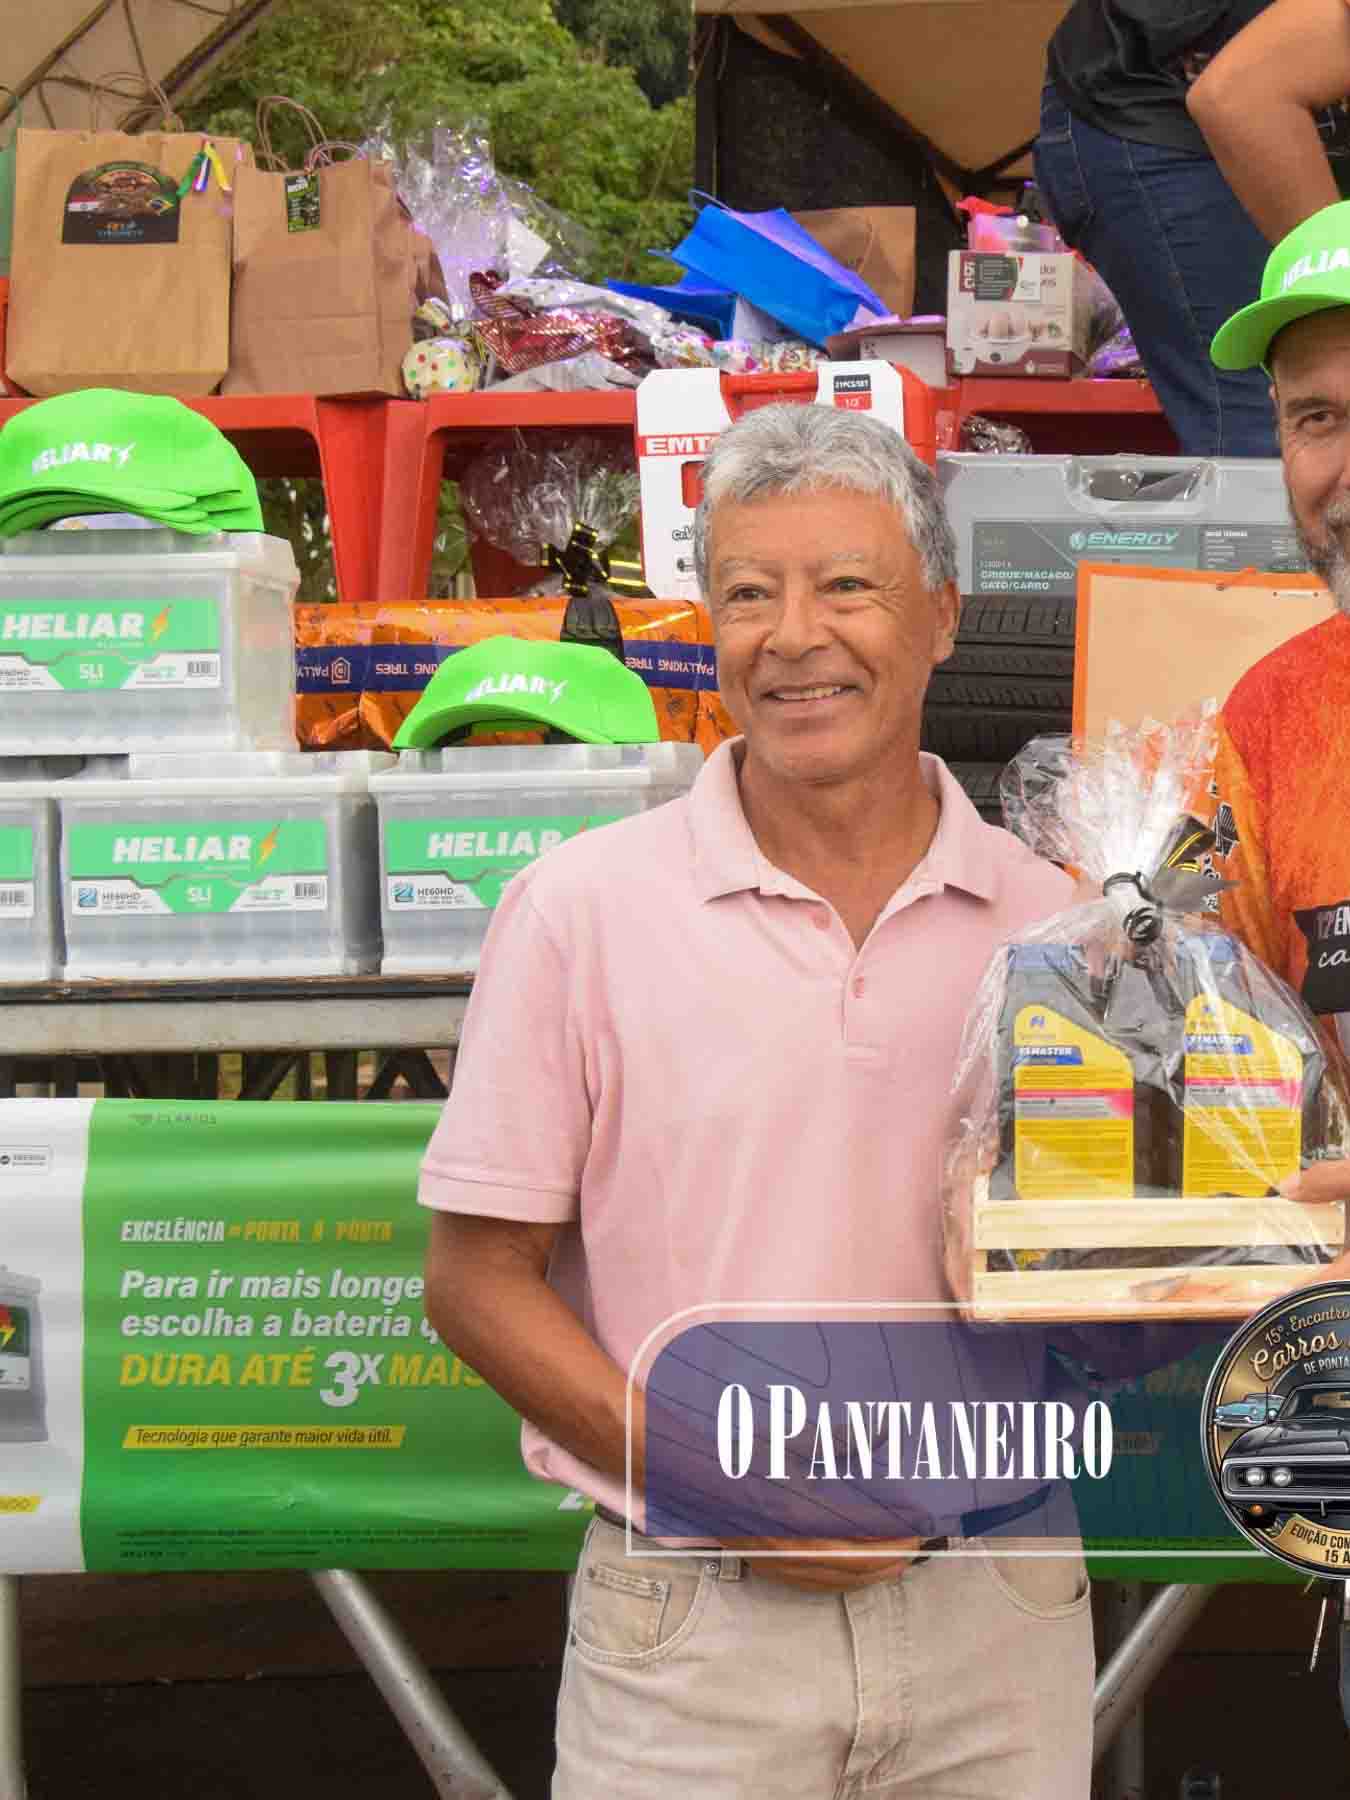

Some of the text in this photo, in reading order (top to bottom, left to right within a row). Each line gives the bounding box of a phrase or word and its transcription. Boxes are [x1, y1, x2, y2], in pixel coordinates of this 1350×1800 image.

[645, 436, 720, 455] EMT
[1088, 532, 1179, 546] ENERGY
[3, 613, 144, 639] HELIAR
[112, 834, 252, 864] HELIAR
[120, 1216, 225, 1244] EXCELÊNCIA
[120, 1270, 199, 1300] Para
[206, 1269, 235, 1299] ir
[239, 1270, 322, 1299] mais
[120, 1308, 254, 1338] escolha
[262, 1314, 283, 1338] a
[289, 1308, 412, 1338] bateria
[119, 1353, 234, 1387] DURA
[239, 1345, 317, 1387] ATÉ
[136, 1429, 209, 1449] Tecnologia
[211, 1432, 238, 1450] que
[240, 1432, 293, 1449] garante
[295, 1429, 334, 1445] maior
[335, 1429, 364, 1445] vida
